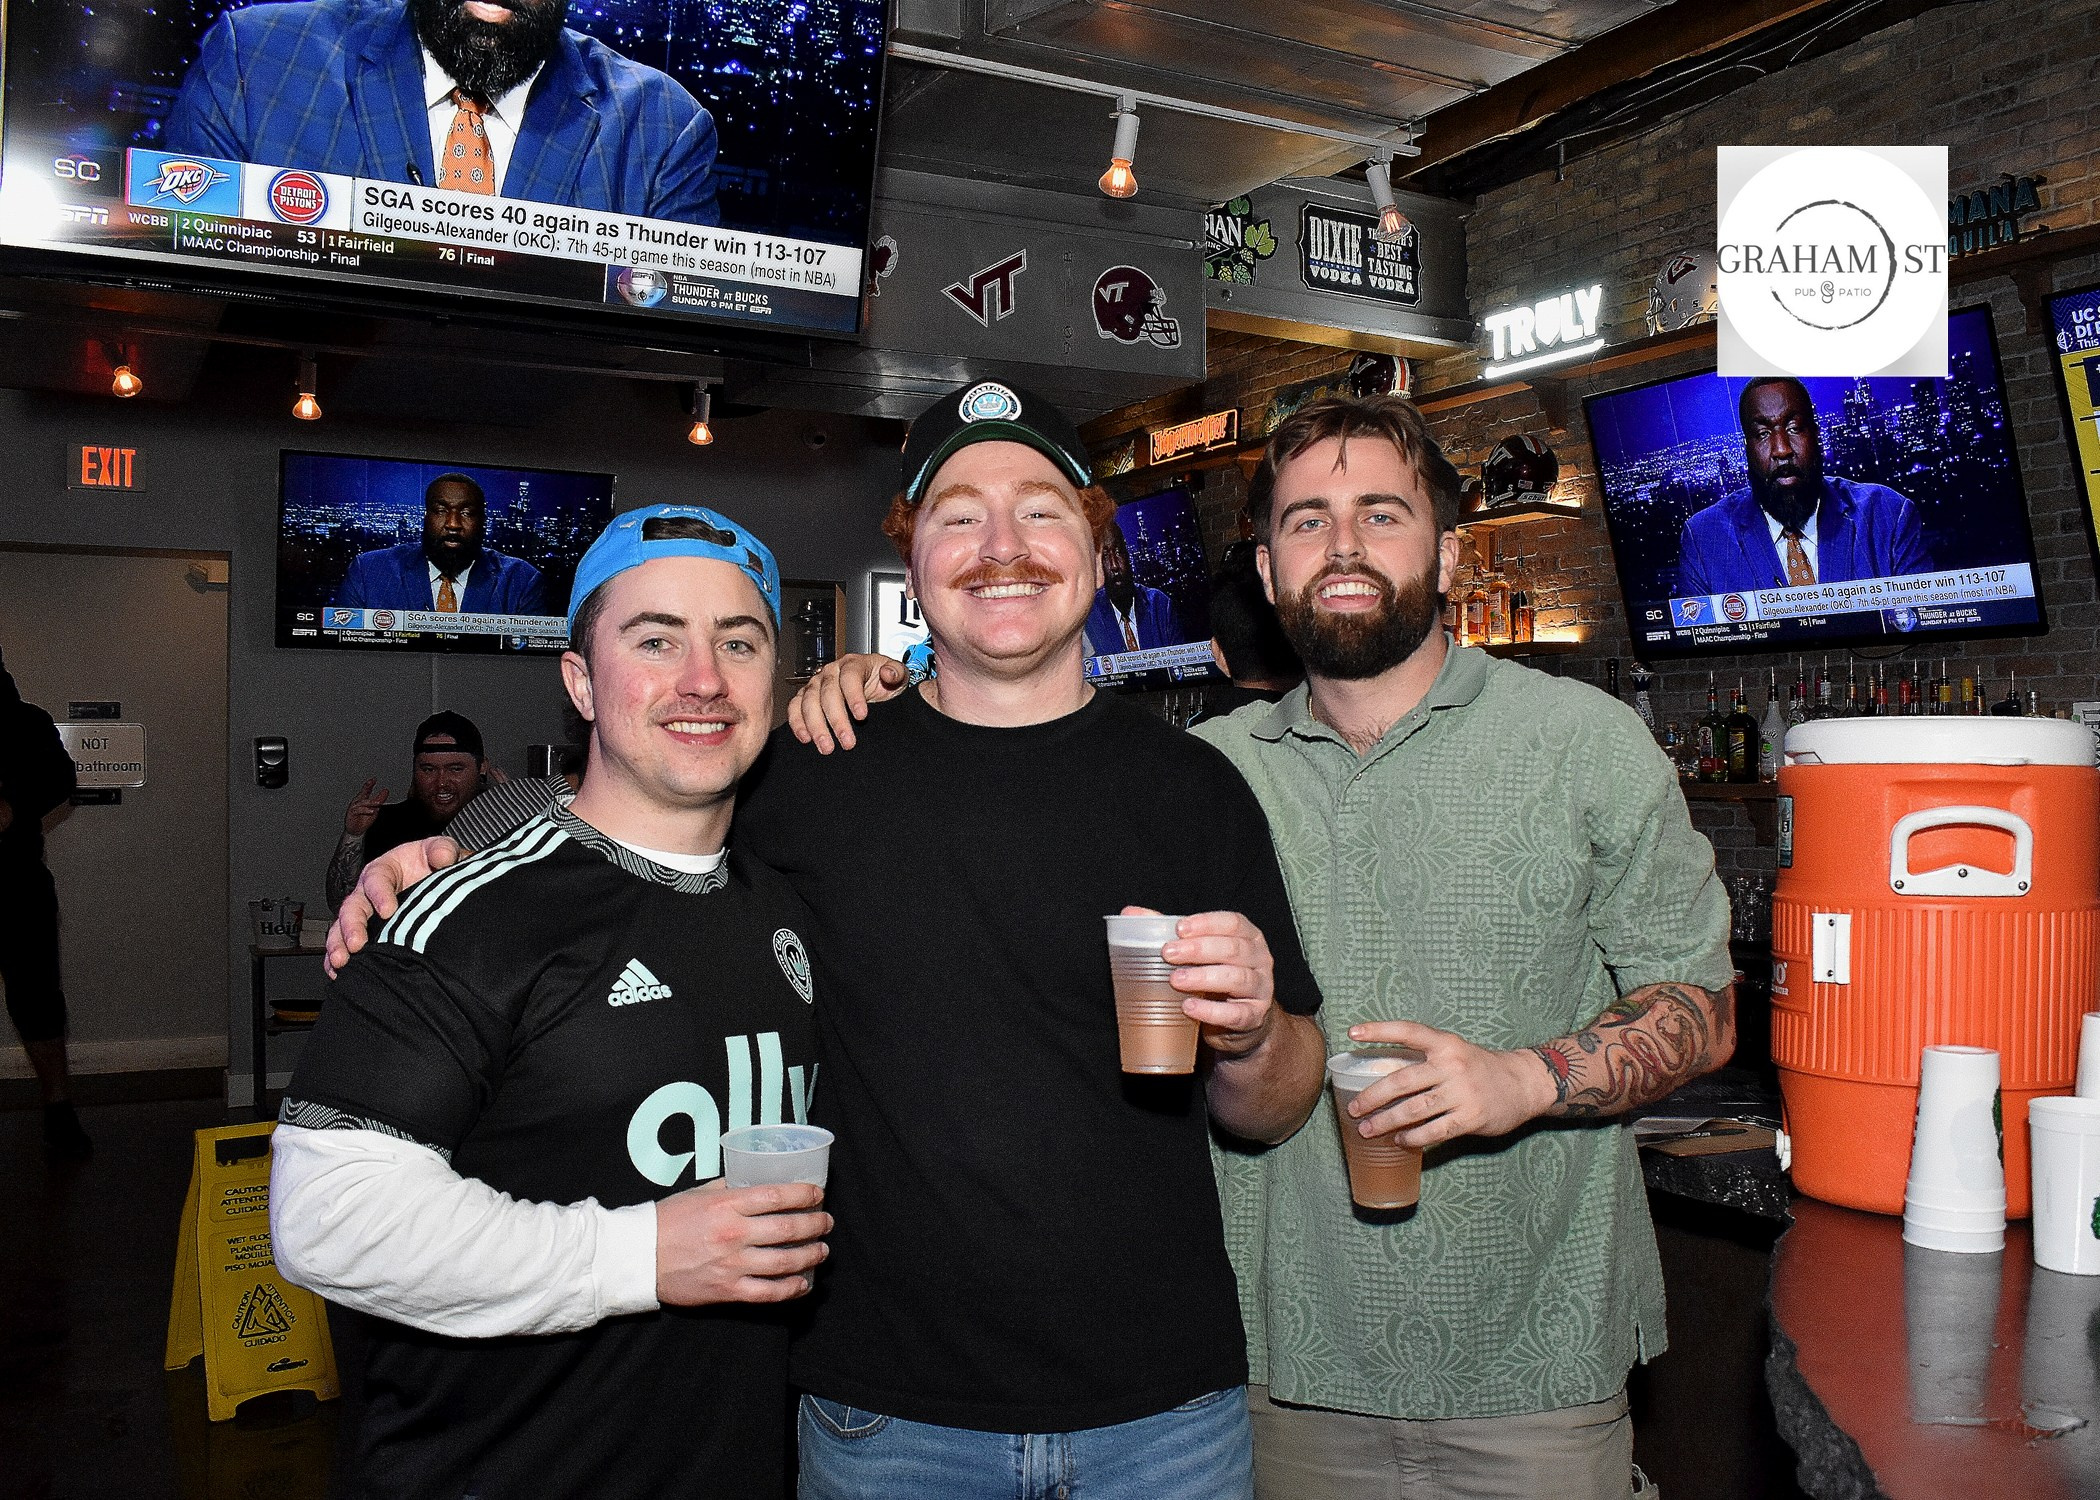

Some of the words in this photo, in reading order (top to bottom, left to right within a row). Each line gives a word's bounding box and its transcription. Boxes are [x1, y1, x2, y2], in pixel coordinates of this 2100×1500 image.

[54, 157, 101, 182] SC
[161, 170, 203, 194] OKC
[279, 185, 317, 199] DETROIT
[279, 193, 317, 210] PISTONS
[57, 203, 109, 226] SPN
[129, 212, 169, 227] WCBB
[182, 218, 190, 229] 2
[193, 218, 273, 239] Quinnipiac
[297, 231, 317, 244] 53
[364, 187, 415, 211] SGA
[421, 198, 495, 221] scores
[501, 206, 527, 225] 40
[533, 212, 590, 234] again
[596, 221, 620, 238] as
[626, 222, 708, 250] Thunder
[713, 235, 746, 256] win
[753, 240, 827, 266] 113-107
[328, 235, 334, 247] 1
[337, 235, 394, 254] Fairfield
[438, 248, 455, 261] 76
[1309, 215, 1362, 268] DIXIE
[1948, 220, 2014, 256] QUILA
[182, 236, 224, 251] MAAC
[226, 239, 320, 263] Championship
[330, 252, 360, 267] Final
[363, 211, 509, 244] Gilgeous-Alexander
[513, 229, 561, 252] (OKC):
[567, 238, 588, 254] 7th
[592, 241, 628, 264] 45-pt
[631, 247, 668, 265] game
[672, 251, 696, 269] this
[700, 258, 746, 275] season
[750, 262, 786, 281] (most
[789, 266, 801, 282] in
[804, 270, 836, 289] NBA)
[466, 252, 495, 266] Final
[1376, 241, 1402, 262] BEST
[1309, 265, 1362, 285] VODKA
[1367, 257, 1413, 280] TASTING
[673, 283, 720, 299] THUNDER
[723, 292, 734, 301] AT
[735, 291, 768, 305] BUCKS
[940, 248, 1027, 328] VT
[1099, 282, 1129, 303] VT
[1368, 274, 1415, 294] VODKA
[672, 295, 709, 308] SUNDAY
[719, 301, 734, 310] PM
[735, 303, 747, 312] ET
[1485, 284, 1602, 362] TRULY
[2072, 307, 2095, 324] UC
[2075, 323, 2093, 338] DI
[2077, 337, 2099, 349] This
[81, 446, 136, 488] EXIT
[1760, 592, 1783, 604] SGA
[1785, 590, 1819, 602] scores
[1822, 588, 1835, 598] 40
[1837, 585, 1867, 599] again
[1869, 584, 1883, 594] as
[1884, 580, 1932, 592] Thunder
[1934, 576, 1956, 588] win
[1958, 570, 2006, 585] 113-107
[1762, 602, 1829, 617] Gilgeous-Alexander
[1892, 595, 1913, 607] game
[1914, 593, 1928, 602] this
[1930, 591, 1959, 601] season
[1986, 587, 1993, 596] in
[296, 613, 314, 621] SC
[408, 612, 427, 622] SGA
[429, 615, 458, 623] scores
[460, 615, 470, 623] 40
[471, 616, 495, 626] again
[508, 618, 543, 626] Thunder
[544, 619, 559, 627] win
[1645, 610, 1664, 620] SC
[1755, 621, 1781, 630] Fairfield
[1646, 631, 1671, 641] ESPN
[81, 738, 110, 750] NOT
[76, 761, 142, 772] bathroom
[608, 984, 673, 1007] adidas
[221, 1194, 269, 1207] ATTENTIO
[226, 1236, 246, 1245] WET
[249, 1233, 271, 1242] FLOO
[230, 1242, 272, 1254] PLANCHE
[224, 1263, 246, 1272] PISO
[248, 1259, 276, 1269] MOJA
[232, 1290, 251, 1330] CAUTION
[265, 1283, 298, 1324] ATTENTION
[244, 1334, 287, 1348] CUIDADO
